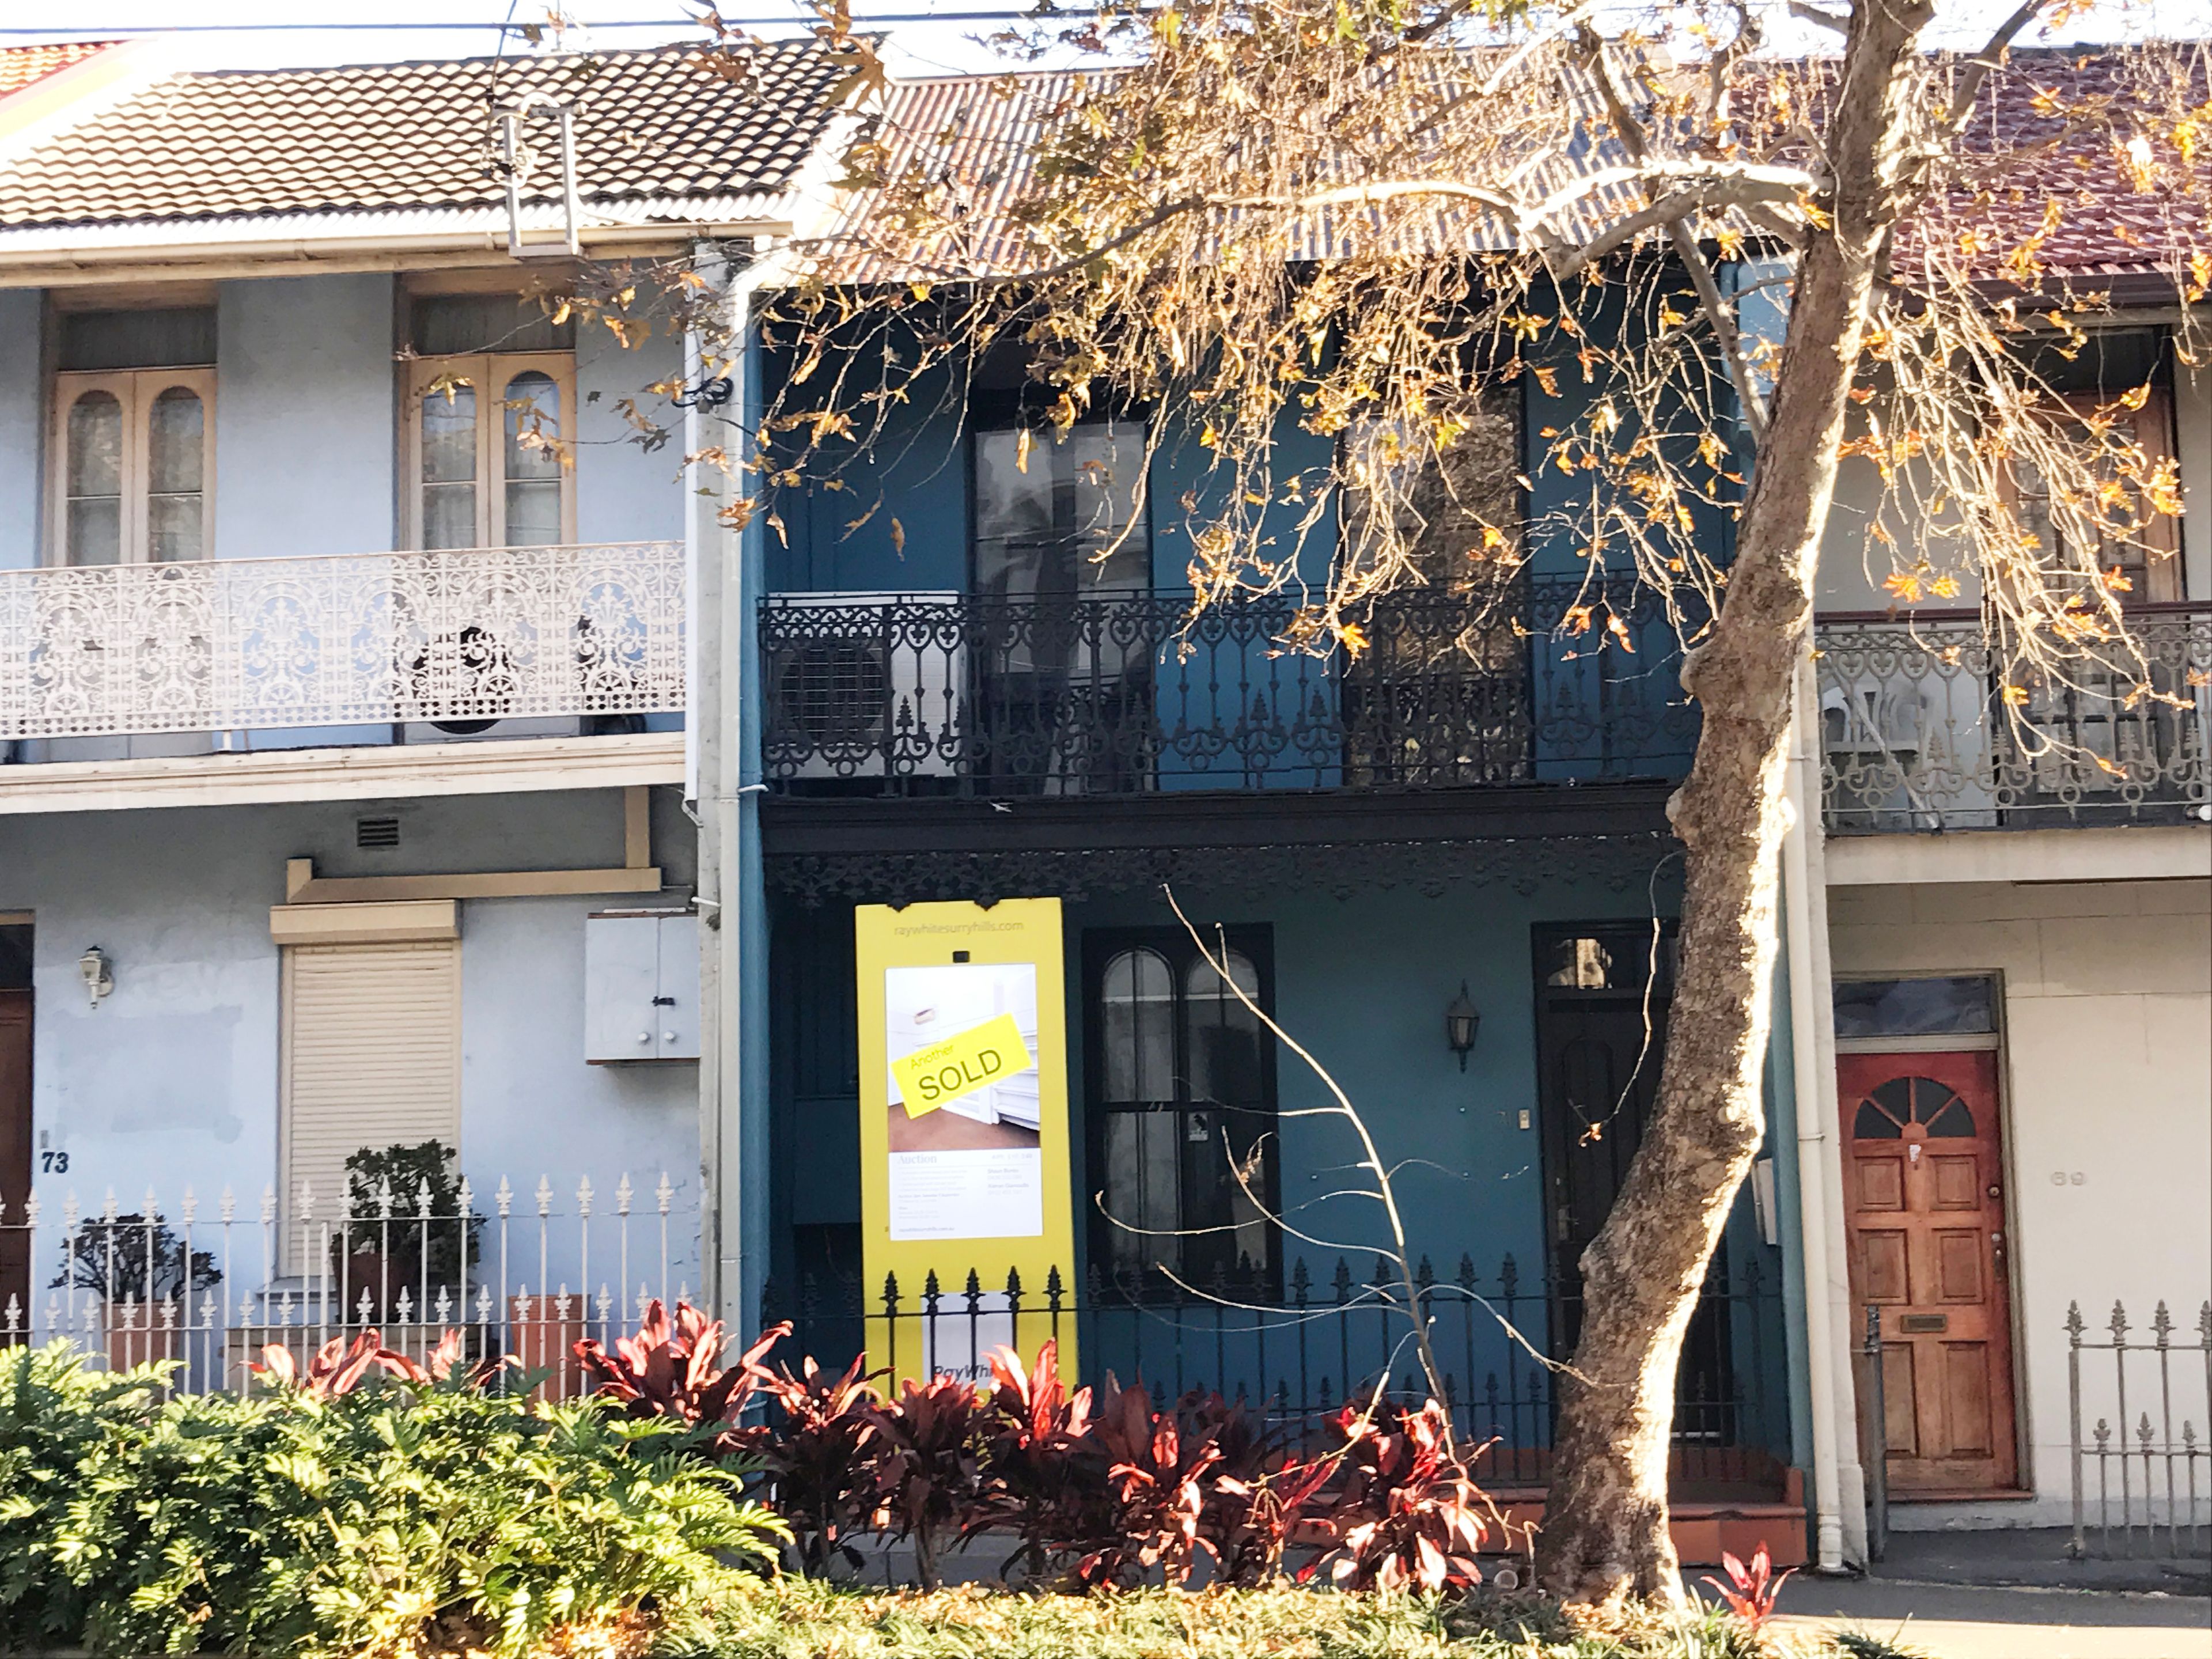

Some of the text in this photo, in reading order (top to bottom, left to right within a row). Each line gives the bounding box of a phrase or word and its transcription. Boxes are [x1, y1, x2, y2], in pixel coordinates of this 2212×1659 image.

[911, 1045, 953, 1070] Another
[919, 1050, 1001, 1100] SOLD
[41, 1152, 69, 1173] 73
[897, 1154, 937, 1164] Auction
